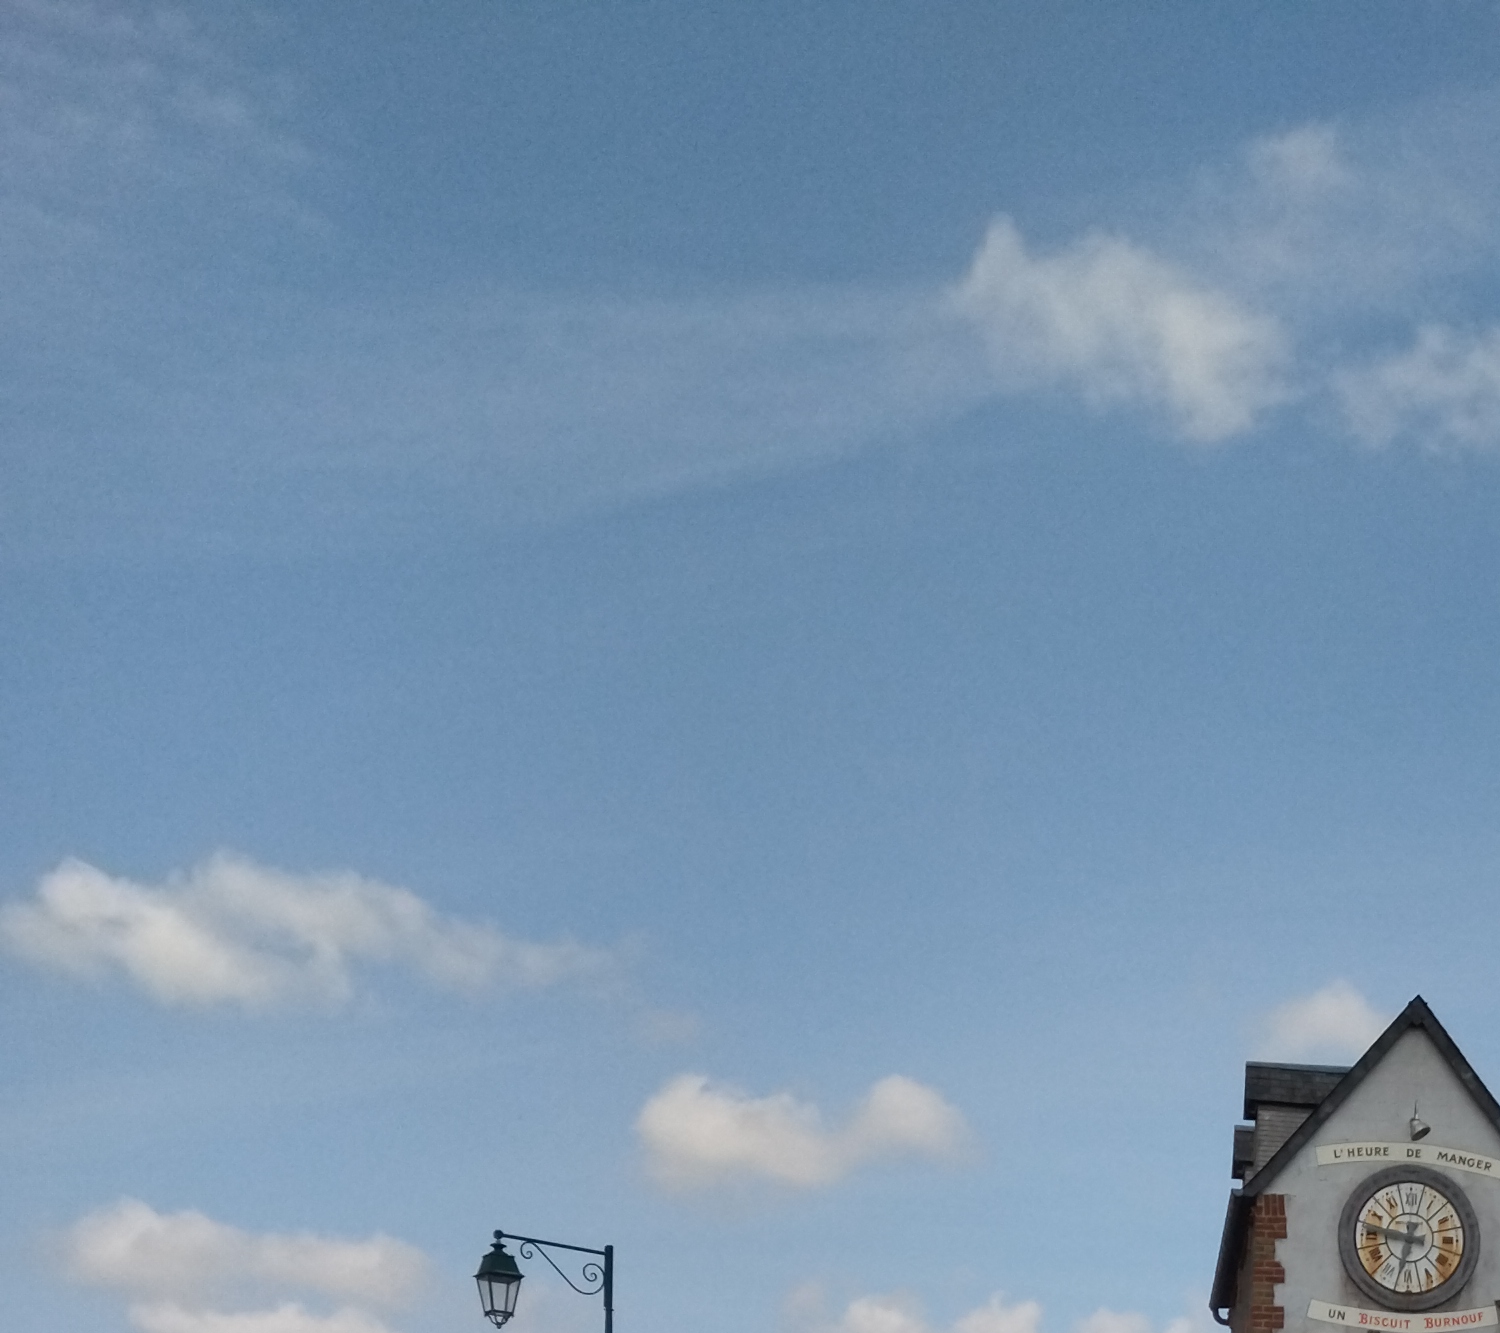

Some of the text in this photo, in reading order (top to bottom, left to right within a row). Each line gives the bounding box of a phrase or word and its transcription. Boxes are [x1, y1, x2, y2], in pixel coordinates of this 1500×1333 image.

[1334, 1146, 1492, 1172] L'HEURE DE MANGER
[1328, 1308, 1346, 1320] UN
